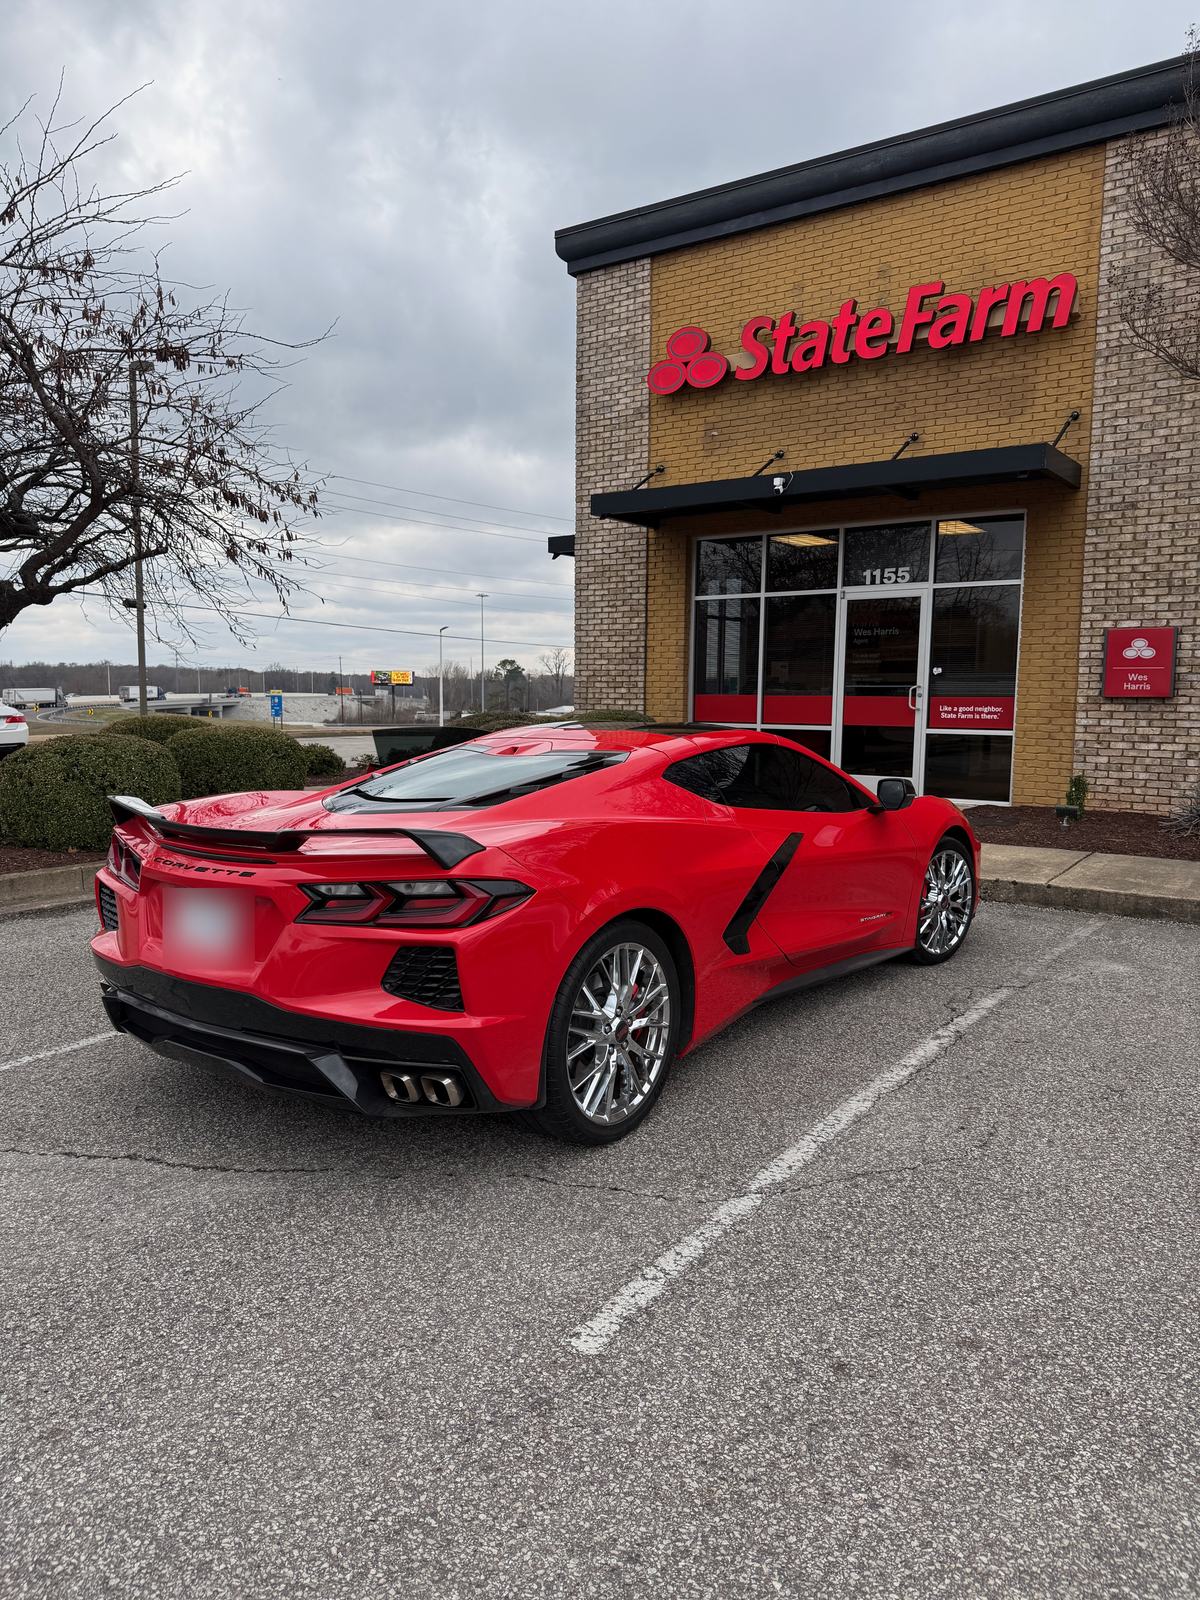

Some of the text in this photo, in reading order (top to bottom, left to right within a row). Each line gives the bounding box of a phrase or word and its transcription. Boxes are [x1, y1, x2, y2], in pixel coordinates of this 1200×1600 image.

[863, 567, 910, 585] 1155
[853, 627, 899, 636] Wes Harris
[1128, 673, 1148, 681] Wes
[1123, 682, 1151, 690] Harris
[958, 705, 974, 713] good
[153, 857, 256, 877] CORVETTE
